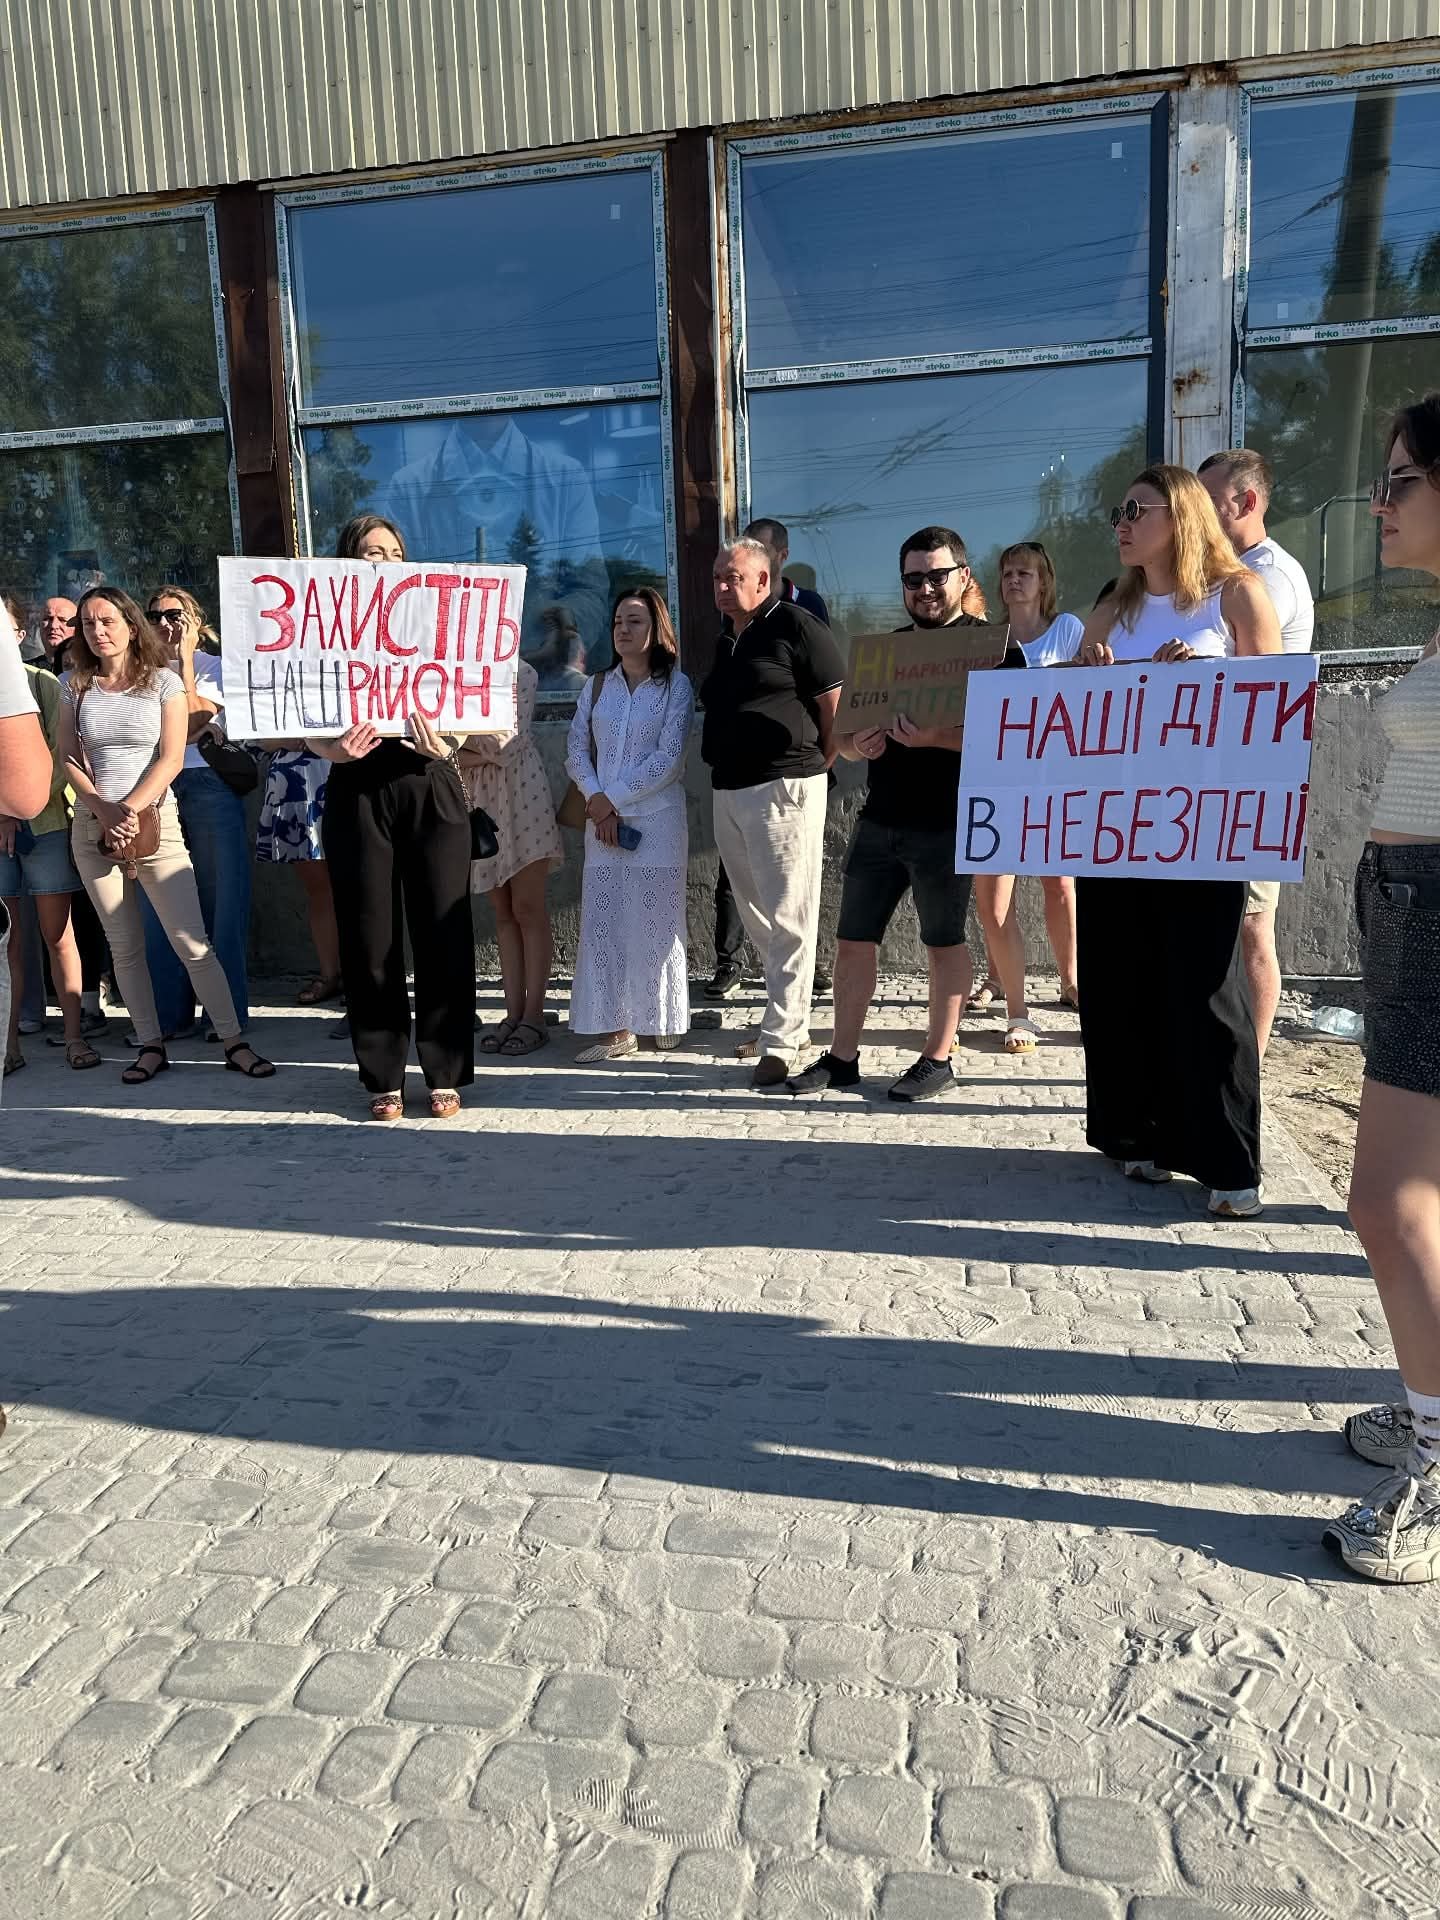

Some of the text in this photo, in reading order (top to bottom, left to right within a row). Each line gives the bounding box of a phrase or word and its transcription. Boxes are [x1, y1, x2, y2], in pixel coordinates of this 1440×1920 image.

[1305, 79, 1334, 89] steko
[1365, 72, 1394, 81] steko
[1426, 66, 1440, 75] ste
[1240, 91, 1248, 116] stek
[773, 139, 799, 147] steko
[827, 132, 853, 141] steko
[880, 125, 906, 135] steko
[935, 119, 961, 129] steko
[990, 112, 1017, 122] steko
[1046, 106, 1073, 116] steko
[1103, 100, 1130, 110] steko
[1240, 147, 1248, 176] steko
[341, 188, 364, 197] steko
[388, 184, 411, 192] steko
[435, 178, 459, 187] steko
[533, 167, 557, 176] steko
[583, 160, 607, 169] steko
[1239, 207, 1247, 235] steko
[1237, 266, 1245, 293] steko
[657, 281, 665, 308] steko
[1253, 335, 1281, 344] steko
[1370, 325, 1398, 334] steko
[820, 348, 1114, 380] steko steko steko steko steko steko
[248, 658, 491, 732] НАШ РАЙОН
[965, 797, 1000, 862] В
